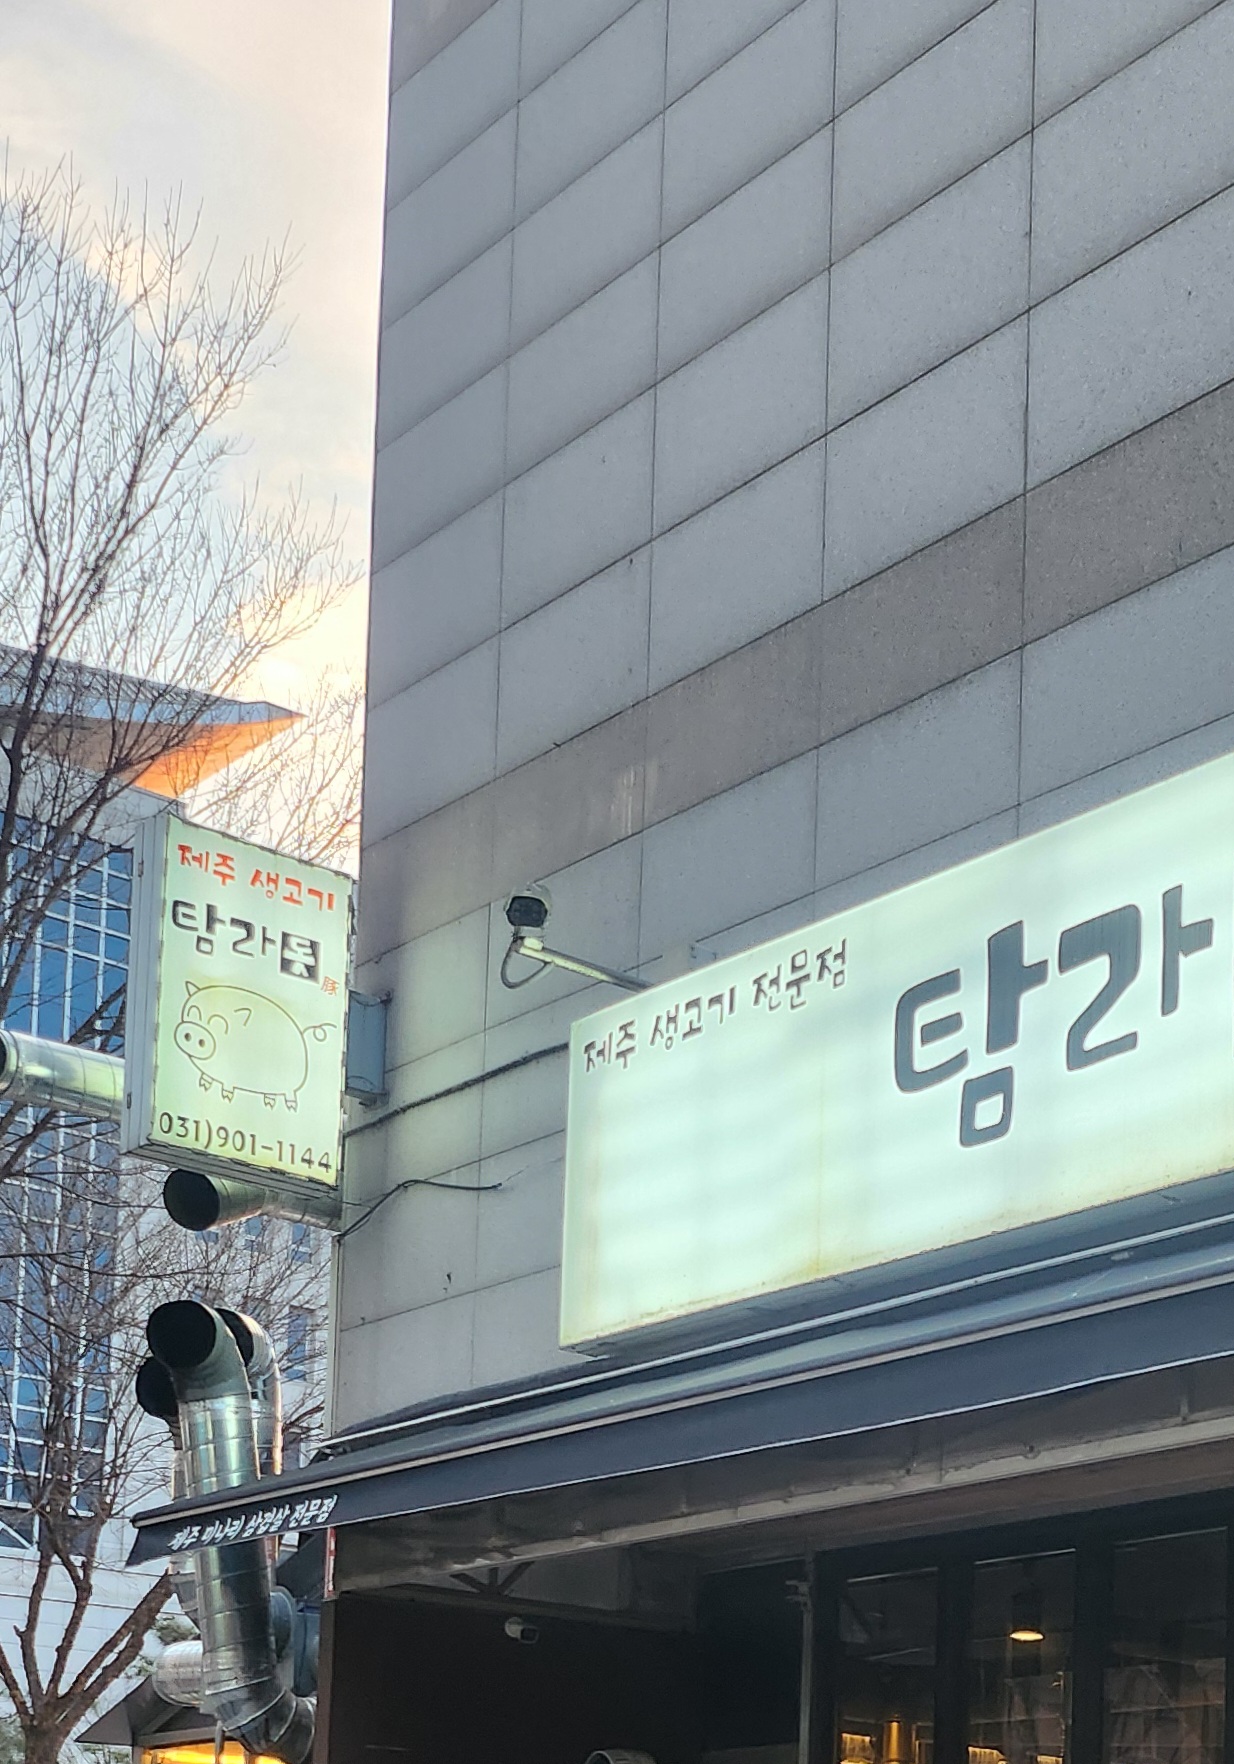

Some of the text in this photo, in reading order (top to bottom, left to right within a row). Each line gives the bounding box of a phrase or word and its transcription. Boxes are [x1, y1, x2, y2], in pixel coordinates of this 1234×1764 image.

[178, 844, 335, 911] 제주 생고기
[172, 900, 320, 983] 탐라돗
[584, 938, 847, 1073] 제주 생고기 전문점
[159, 1112, 332, 1173] 031)901-1144
[168, 1526, 201, 1550] 제주
[201, 1515, 245, 1545] 미나리
[288, 1494, 338, 1528] 전문점
